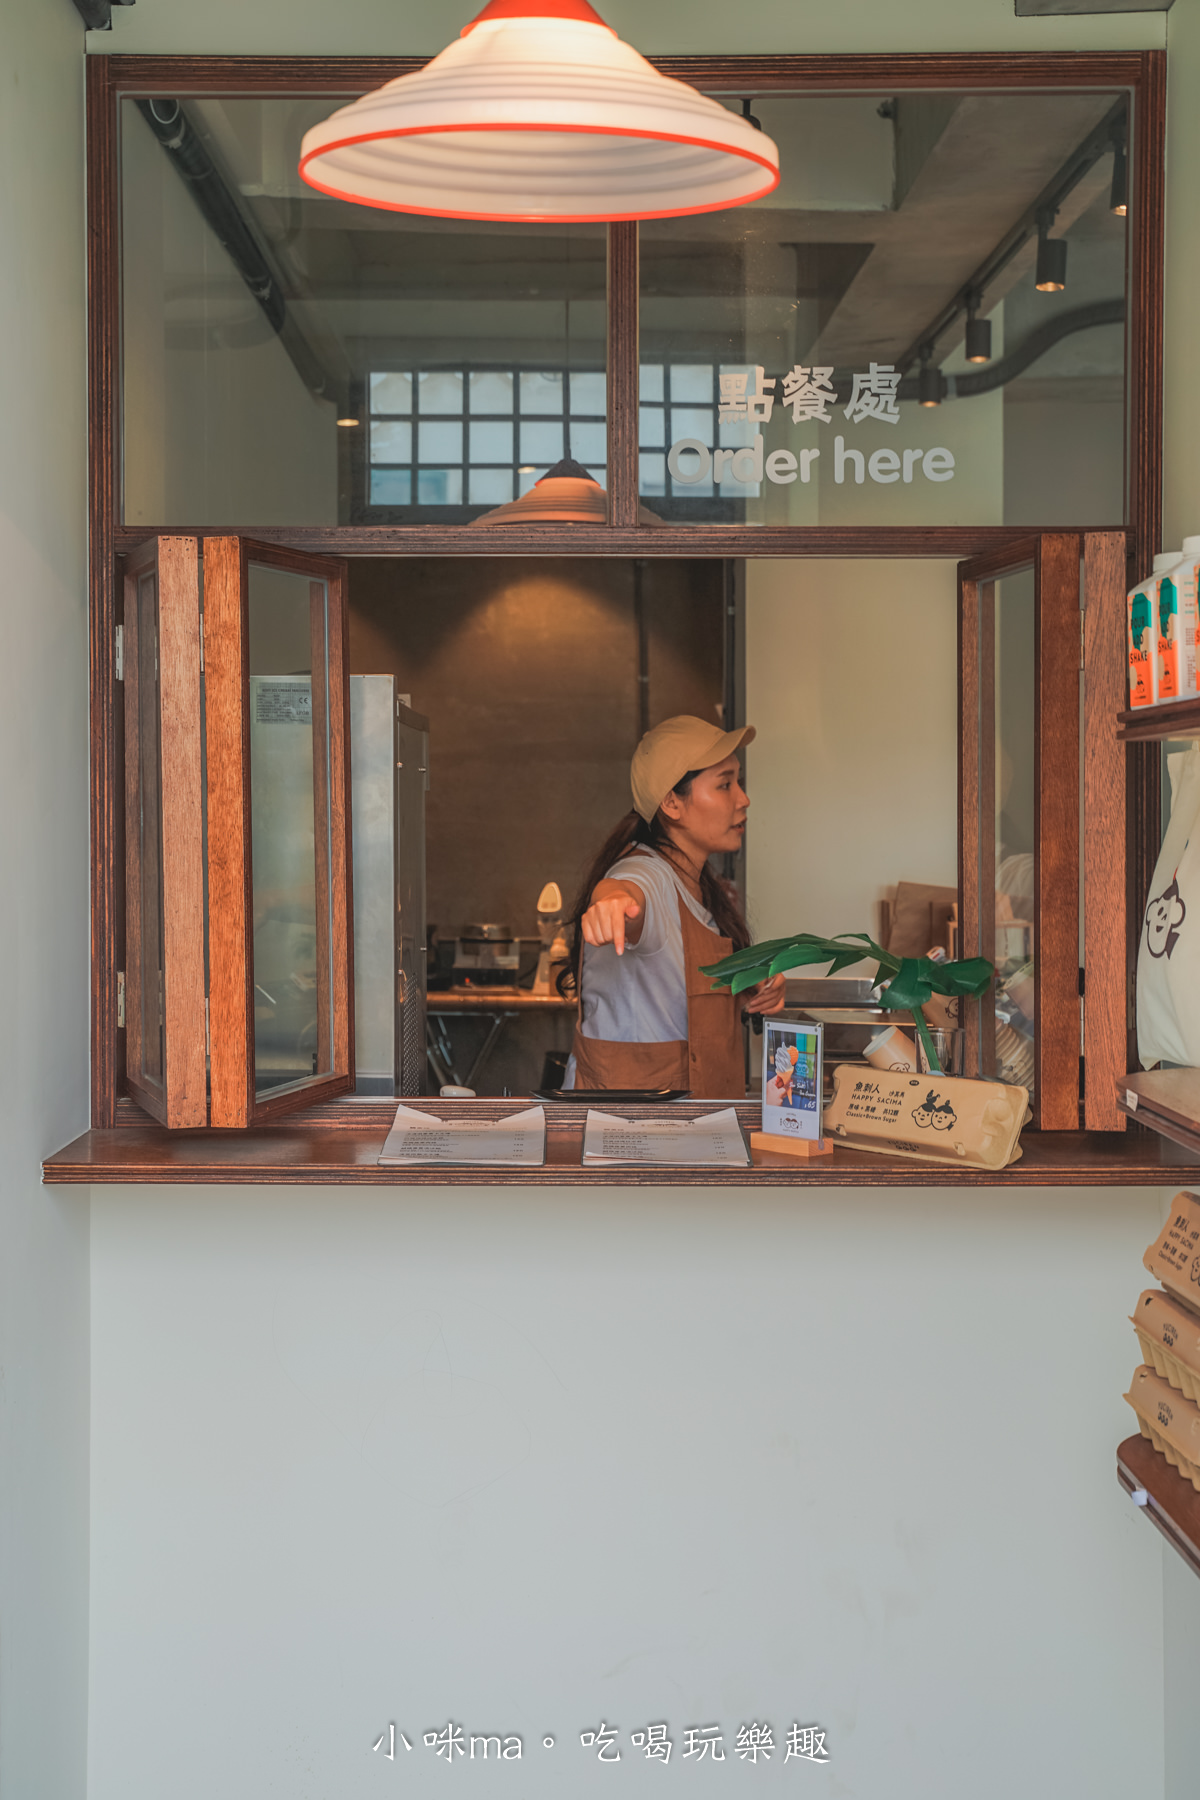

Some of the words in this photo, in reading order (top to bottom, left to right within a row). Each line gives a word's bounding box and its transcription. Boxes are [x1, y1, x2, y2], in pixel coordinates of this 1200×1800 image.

[718, 361, 902, 425] 點餐處
[668, 433, 820, 485] Order
[834, 435, 956, 485] here
[1130, 650, 1148, 664] SHAKE
[851, 1093, 874, 1102] HAPPY
[876, 1097, 902, 1106] SACIMA
